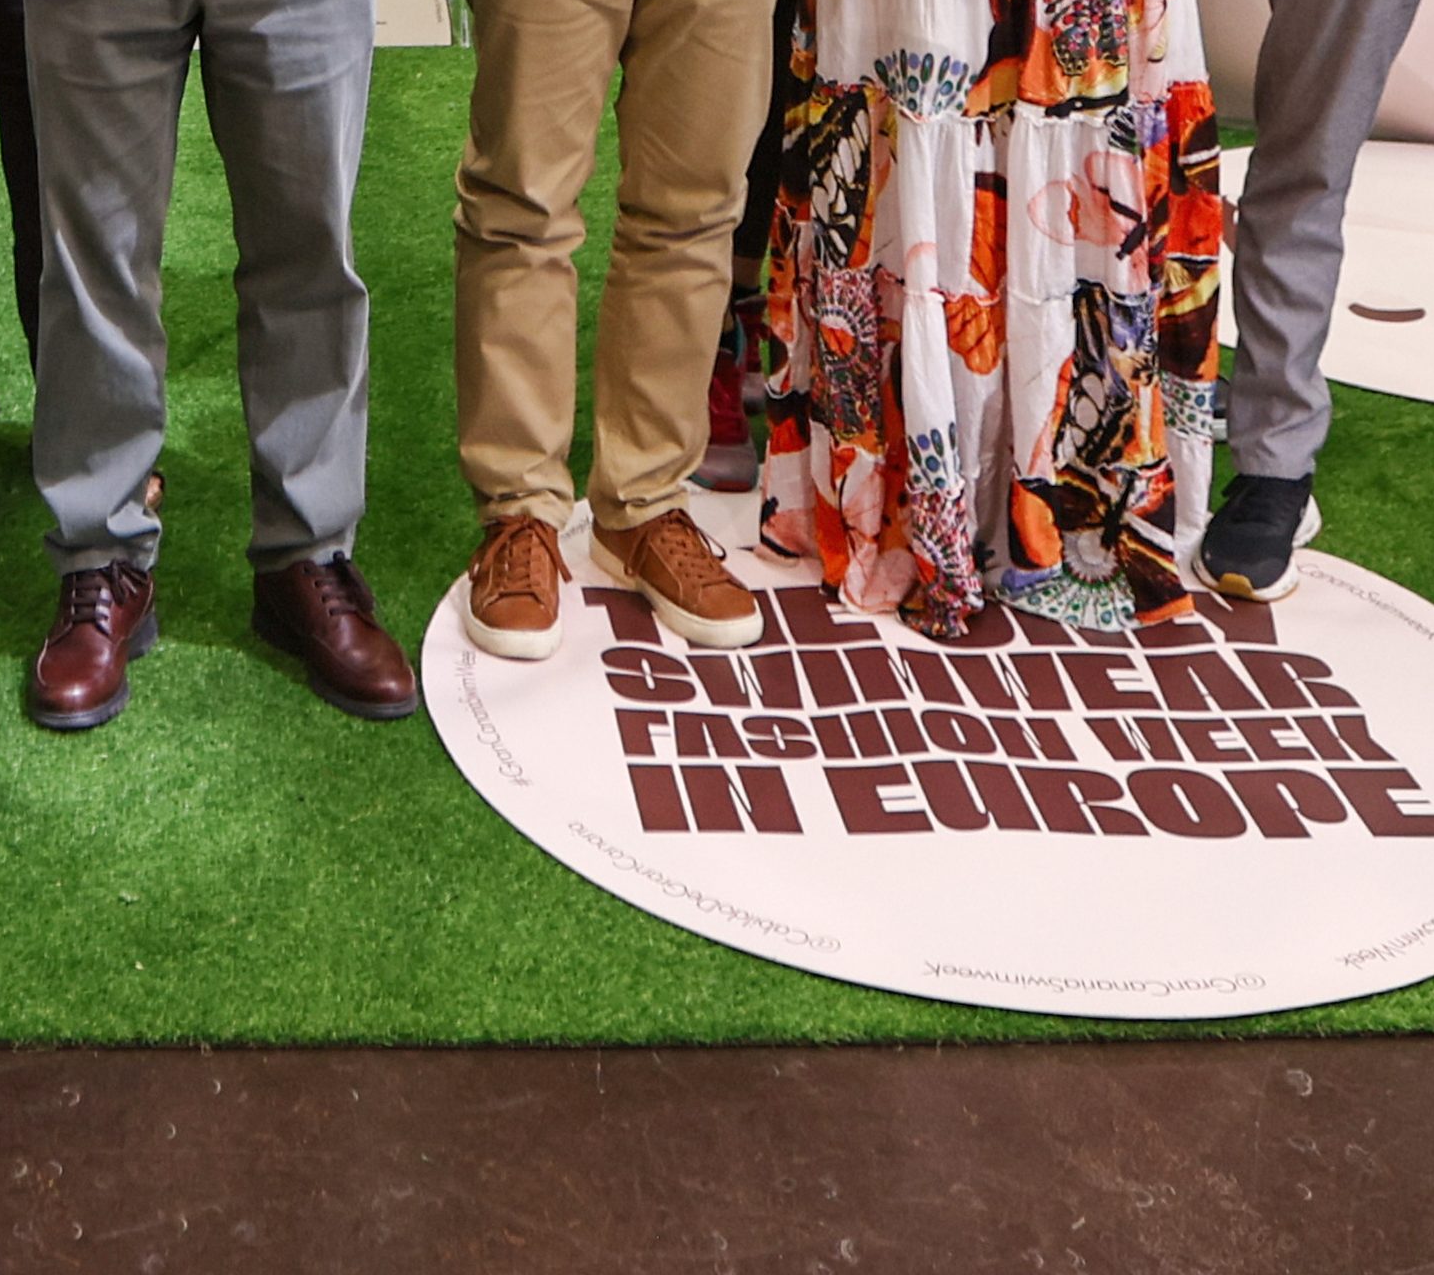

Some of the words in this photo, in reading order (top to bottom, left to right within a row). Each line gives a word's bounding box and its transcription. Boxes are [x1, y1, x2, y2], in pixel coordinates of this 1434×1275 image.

[600, 646, 1362, 710] SWIMWEAR
[614, 707, 1079, 761] FASHION
[1083, 714, 1400, 762] WEEK
[627, 763, 805, 834] IN
